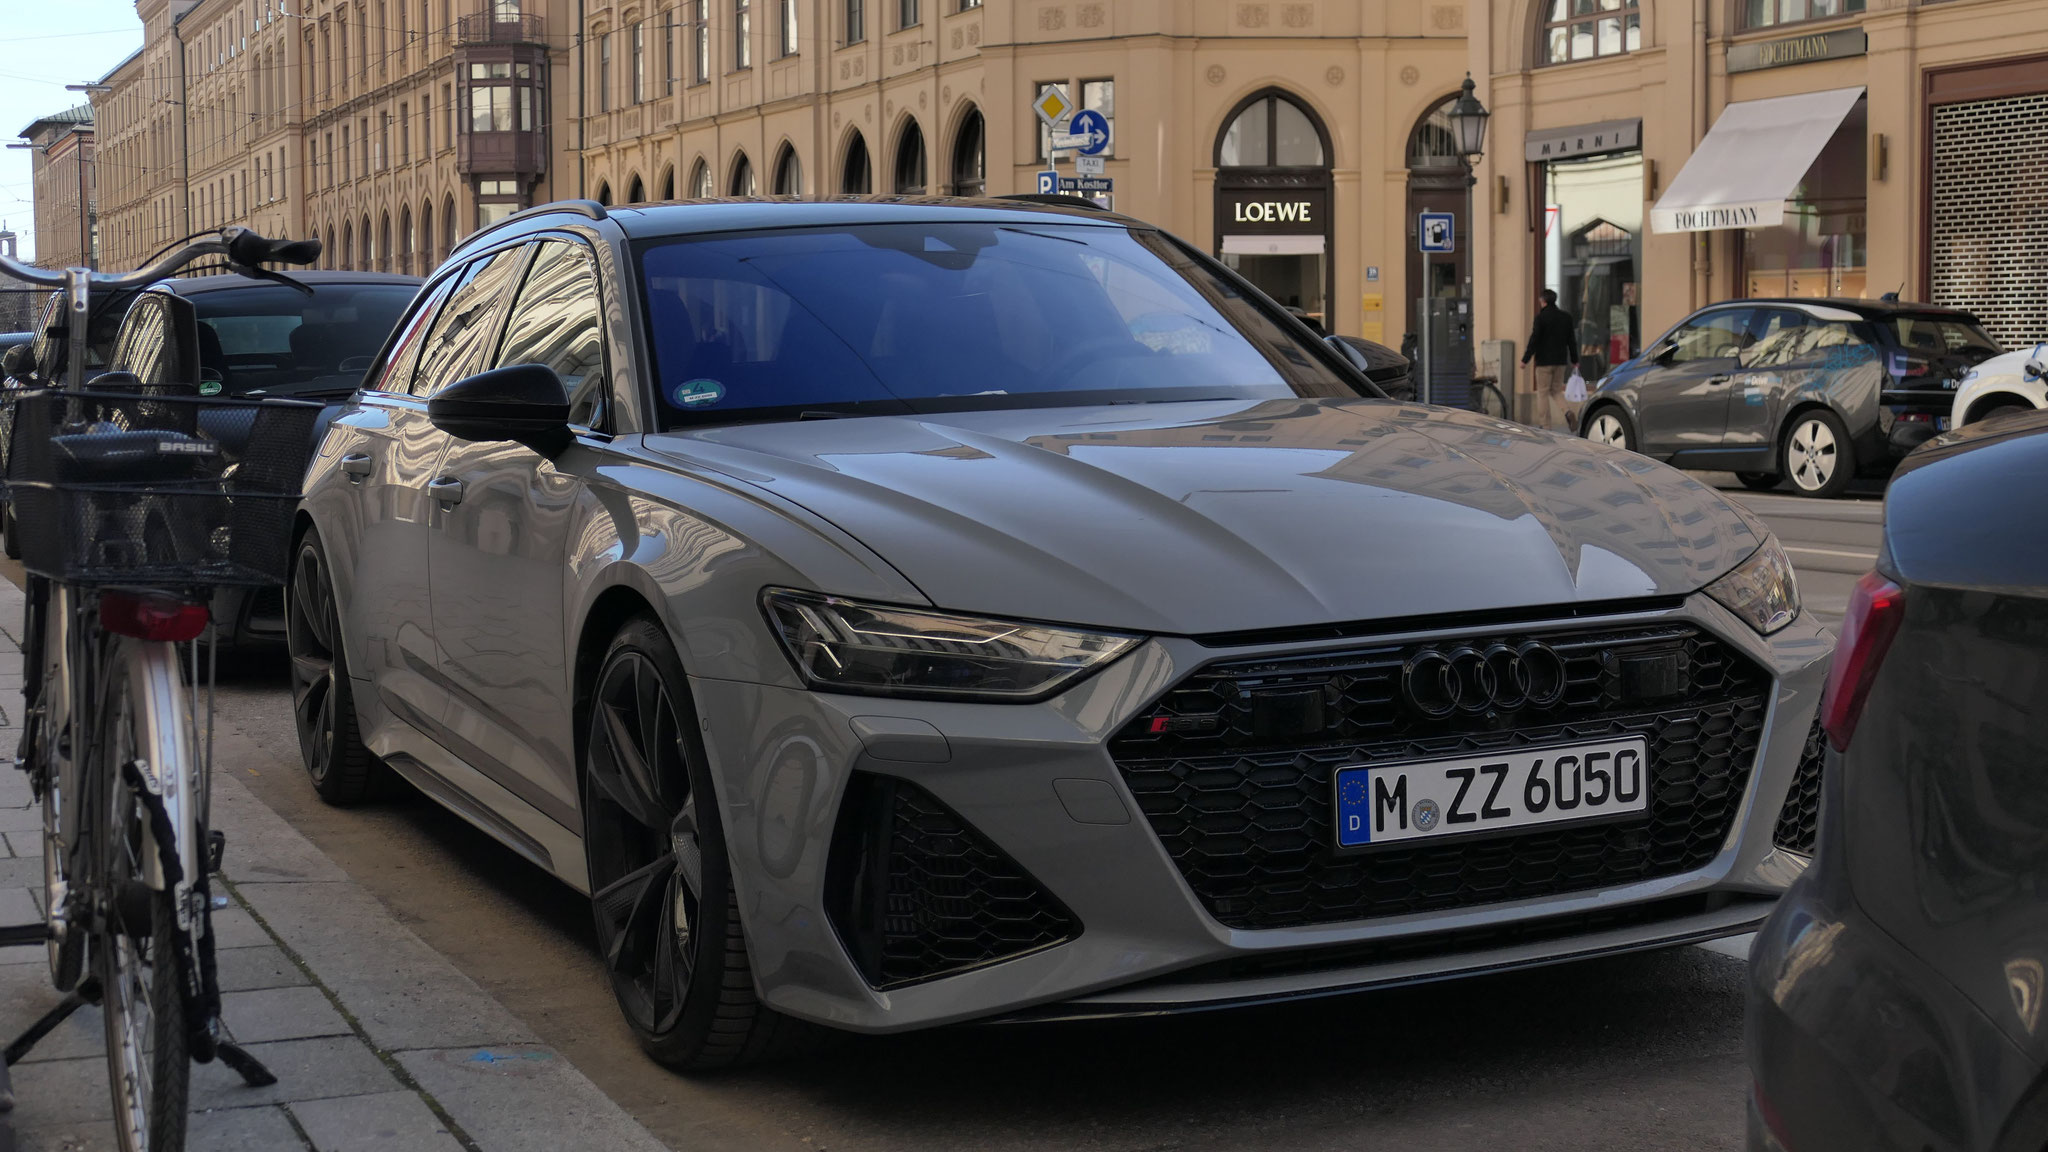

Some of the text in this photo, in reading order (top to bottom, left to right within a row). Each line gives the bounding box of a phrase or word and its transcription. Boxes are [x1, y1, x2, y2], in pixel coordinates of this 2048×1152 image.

[1760, 35, 1828, 65] FOCHTMANN
[1541, 132, 1619, 155] MARNI
[1082, 158, 1099, 167] TAXI
[1040, 175, 1052, 194] P
[1059, 179, 1075, 189] Am
[1235, 202, 1312, 222] LOEWE
[1675, 206, 1759, 230] FOCHTMANN
[159, 442, 214, 453] BASIL
[1349, 815, 1361, 831] D
[1375, 774, 1408, 832] M
[1445, 763, 1511, 825] ZZ
[1523, 749, 1640, 814] 6050
